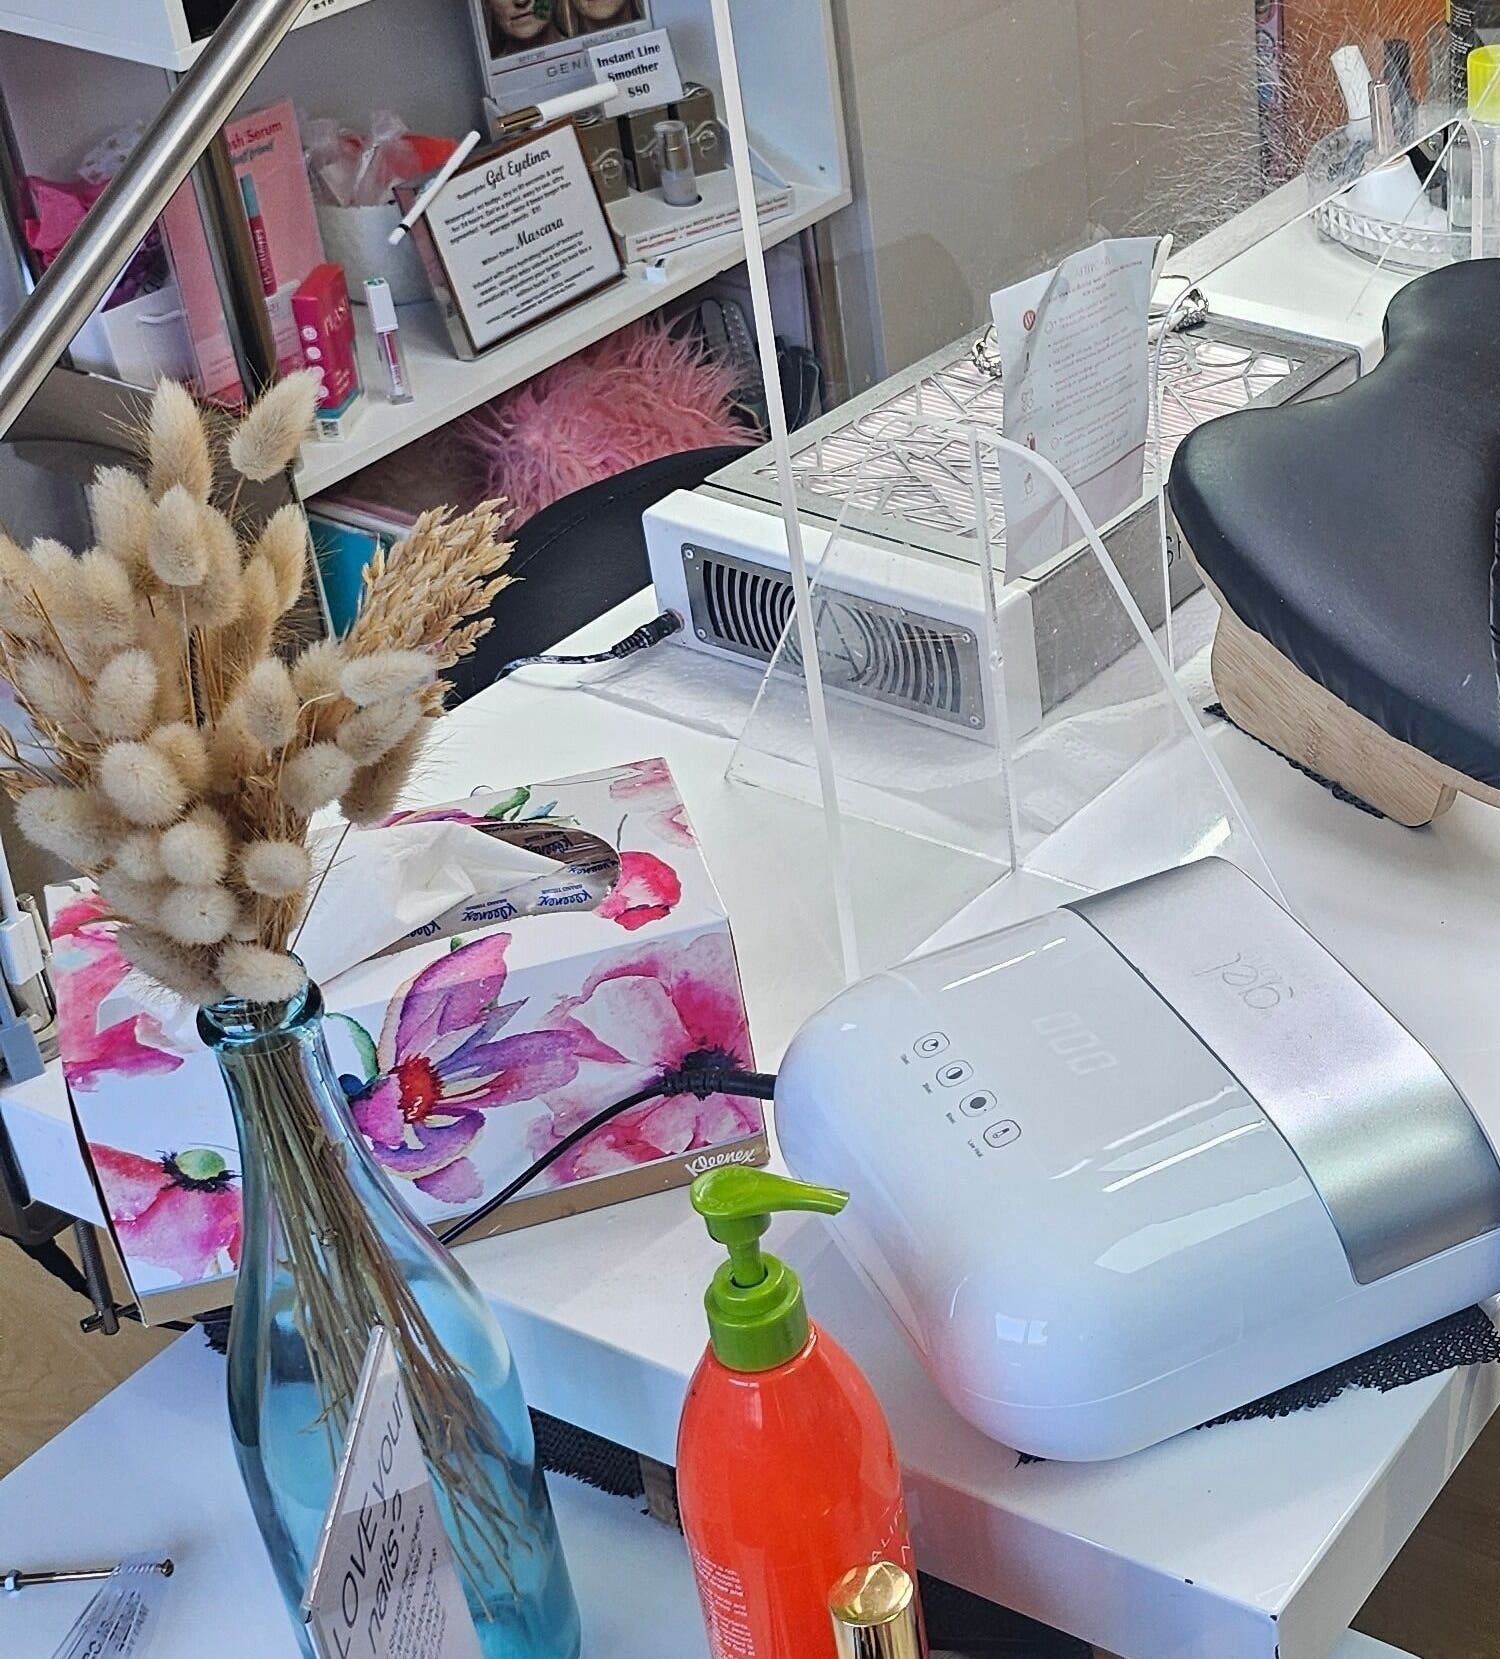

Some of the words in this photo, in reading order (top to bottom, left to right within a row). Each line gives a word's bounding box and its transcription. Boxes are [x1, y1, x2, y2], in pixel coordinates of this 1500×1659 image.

[597, 50, 636, 68] Instant
[637, 44, 661, 58] Line
[547, 57, 590, 78] GENI
[607, 62, 659, 82] Smoother
[247, 122, 282, 143] Serum
[486, 166, 505, 188] Gel
[508, 150, 551, 176] Eyeliner
[515, 217, 564, 249] Mascara
[537, 889, 593, 907] Kleenex
[461, 902, 518, 922] Kleenex
[684, 1148, 756, 1178] Kleenex
[371, 1381, 404, 1519] your
